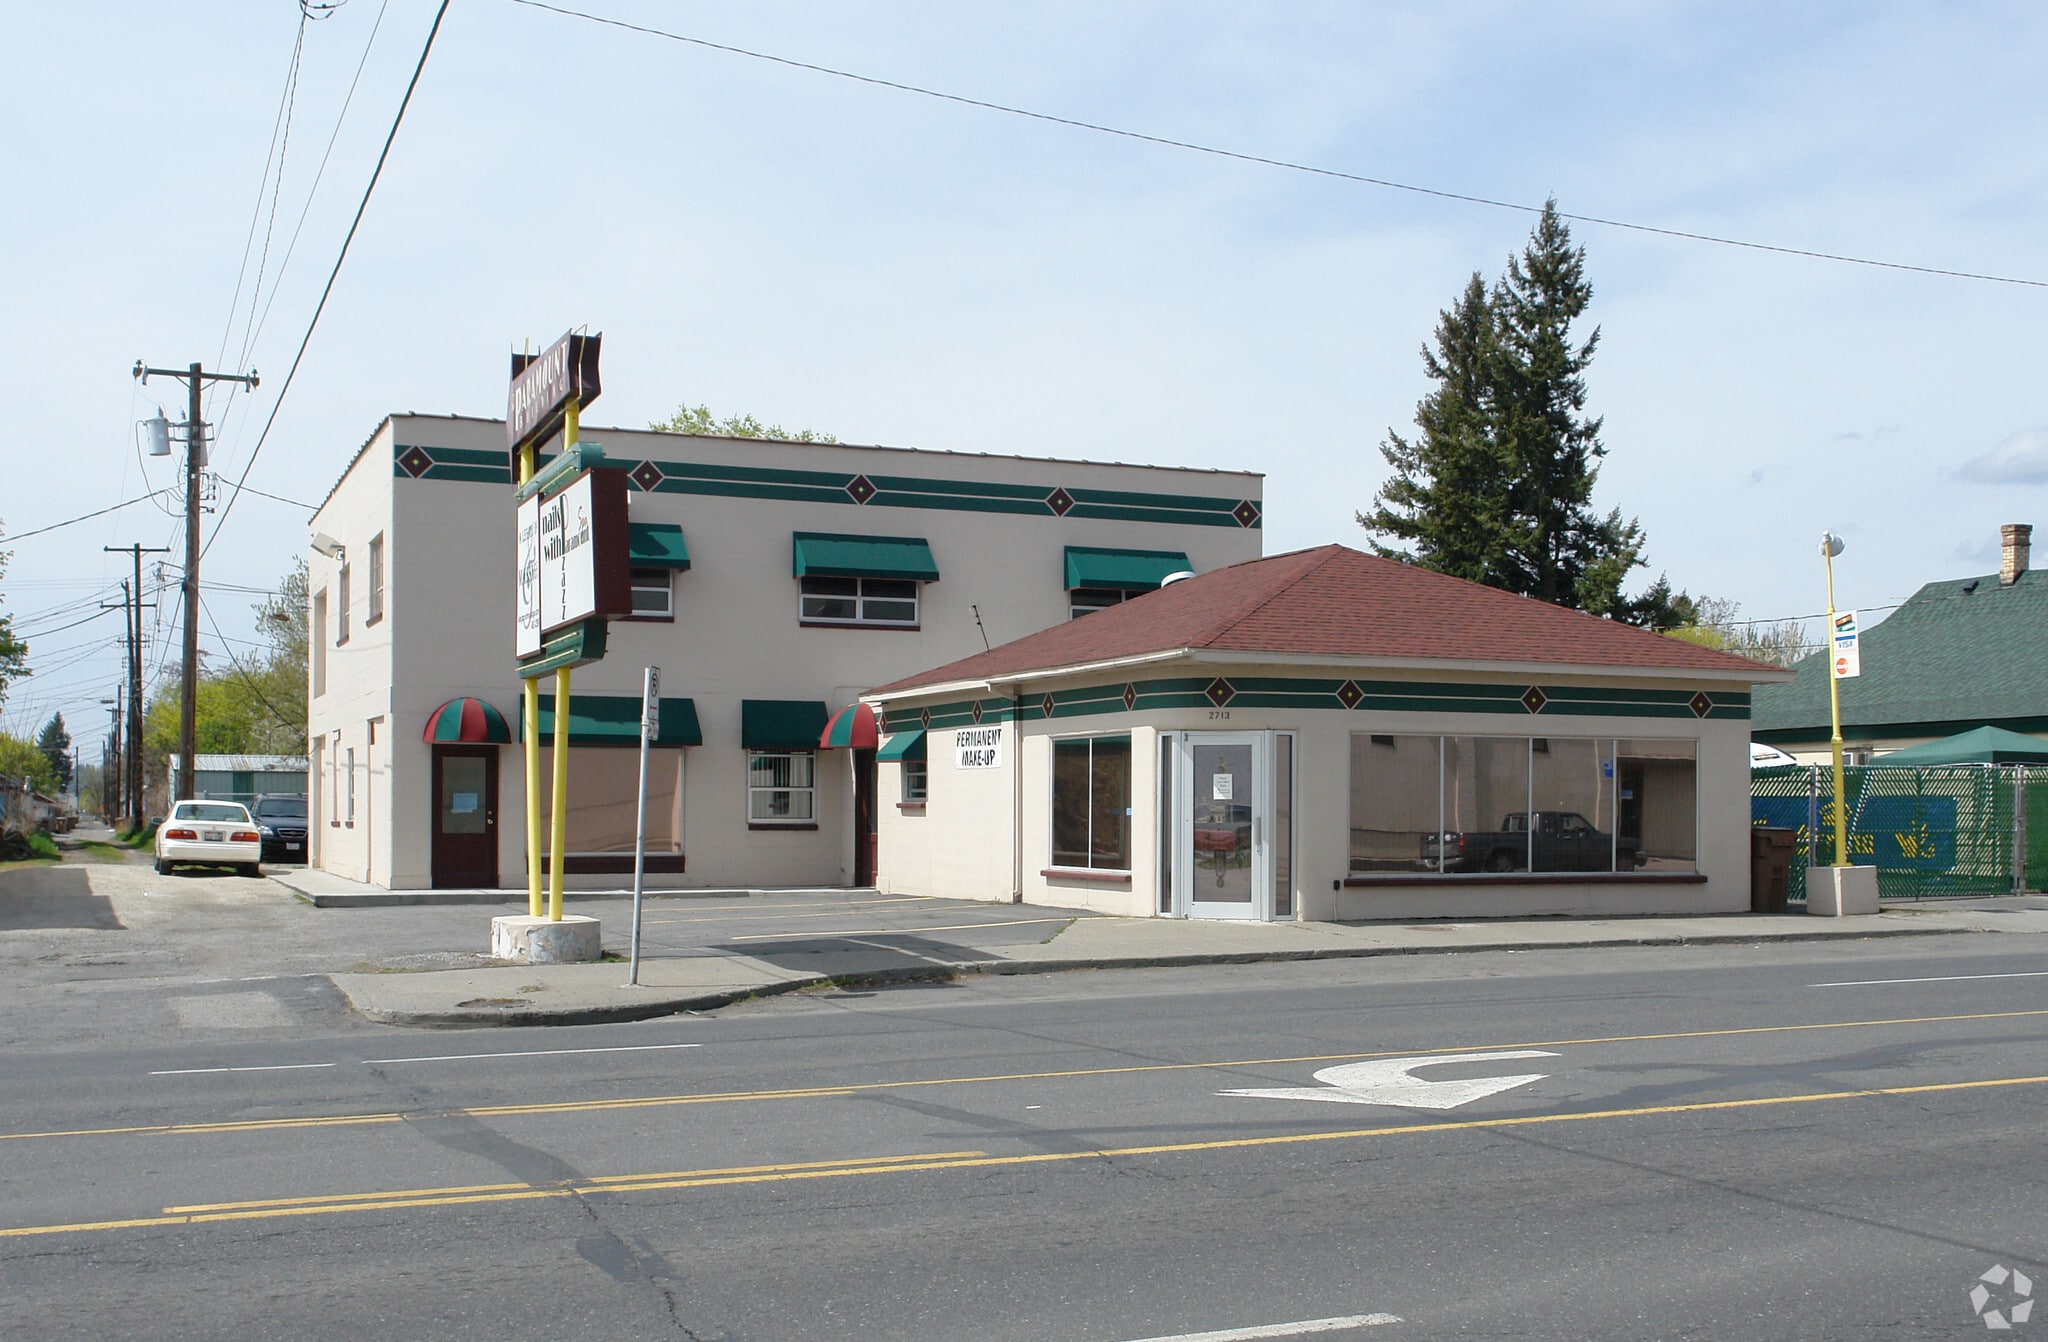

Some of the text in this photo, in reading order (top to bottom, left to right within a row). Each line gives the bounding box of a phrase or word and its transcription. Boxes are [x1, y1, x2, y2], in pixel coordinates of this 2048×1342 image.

[515, 341, 567, 431] PARAMOUNT
[542, 504, 561, 535] nails
[544, 534, 562, 563] with
[1838, 640, 1853, 649] VISA
[1208, 711, 1230, 720] 2713
[956, 728, 1002, 747] PERMANENT
[961, 749, 996, 766] MAKE-UP
